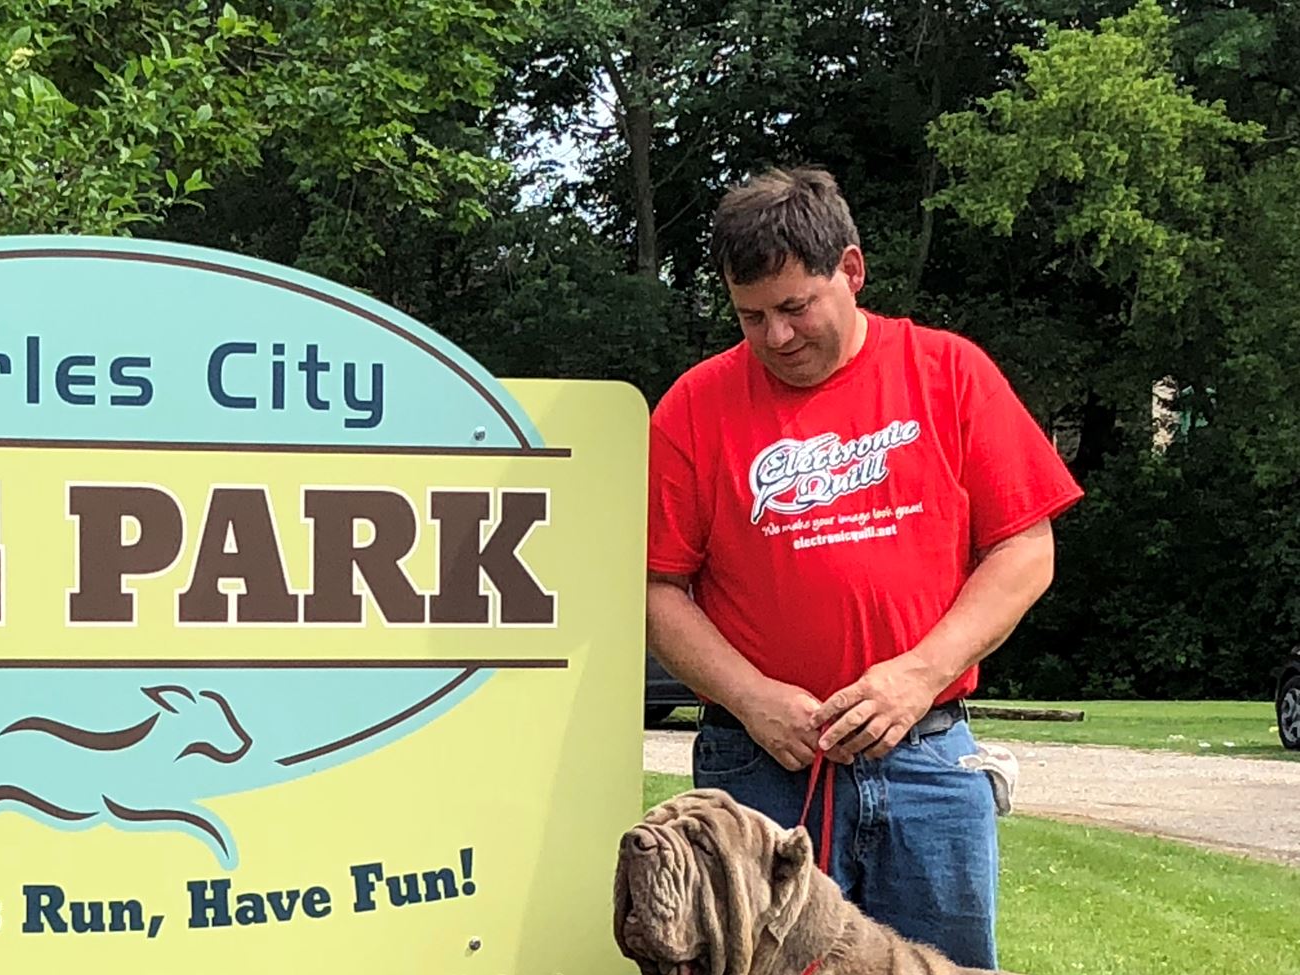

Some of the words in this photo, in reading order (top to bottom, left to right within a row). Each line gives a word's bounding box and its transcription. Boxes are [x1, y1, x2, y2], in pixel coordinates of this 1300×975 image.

[207, 342, 384, 430] City
[755, 420, 920, 485] Electronic
[796, 452, 888, 505] Quill
[782, 518, 810, 532] make
[812, 516, 835, 531] your
[838, 512, 870, 525] image
[873, 506, 894, 519] look
[793, 524, 898, 550] electronicquill.net
[67, 484, 556, 626] PARK
[22, 884, 165, 938] Run,
[186, 878, 332, 929] Have
[349, 847, 476, 913] Fun!
